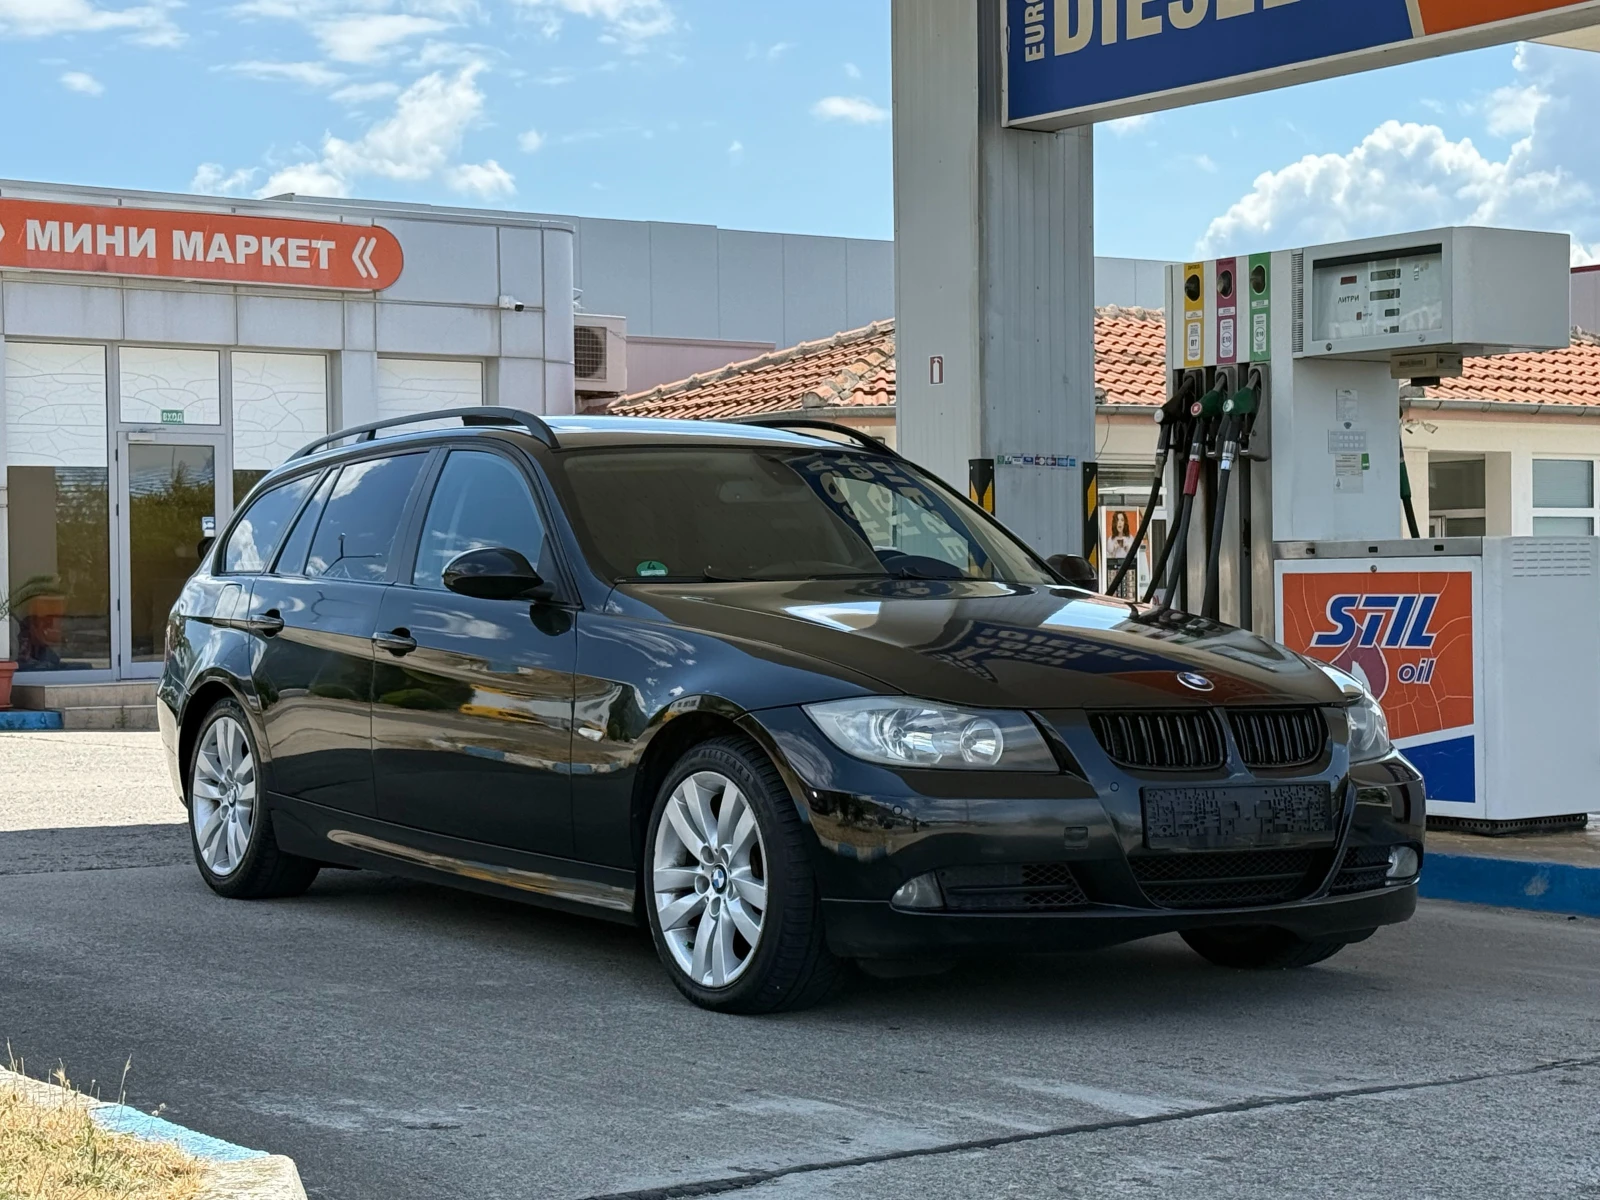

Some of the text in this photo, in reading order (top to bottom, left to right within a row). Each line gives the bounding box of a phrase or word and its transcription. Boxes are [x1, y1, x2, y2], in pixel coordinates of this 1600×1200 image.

[1024, 0, 1045, 62] EUR
[1054, 0, 1301, 56] DIE
[25, 219, 336, 270] МИНИ МАРКЕТ
[162, 412, 184, 424] ВХОД
[1397, 658, 1437, 685] oil
